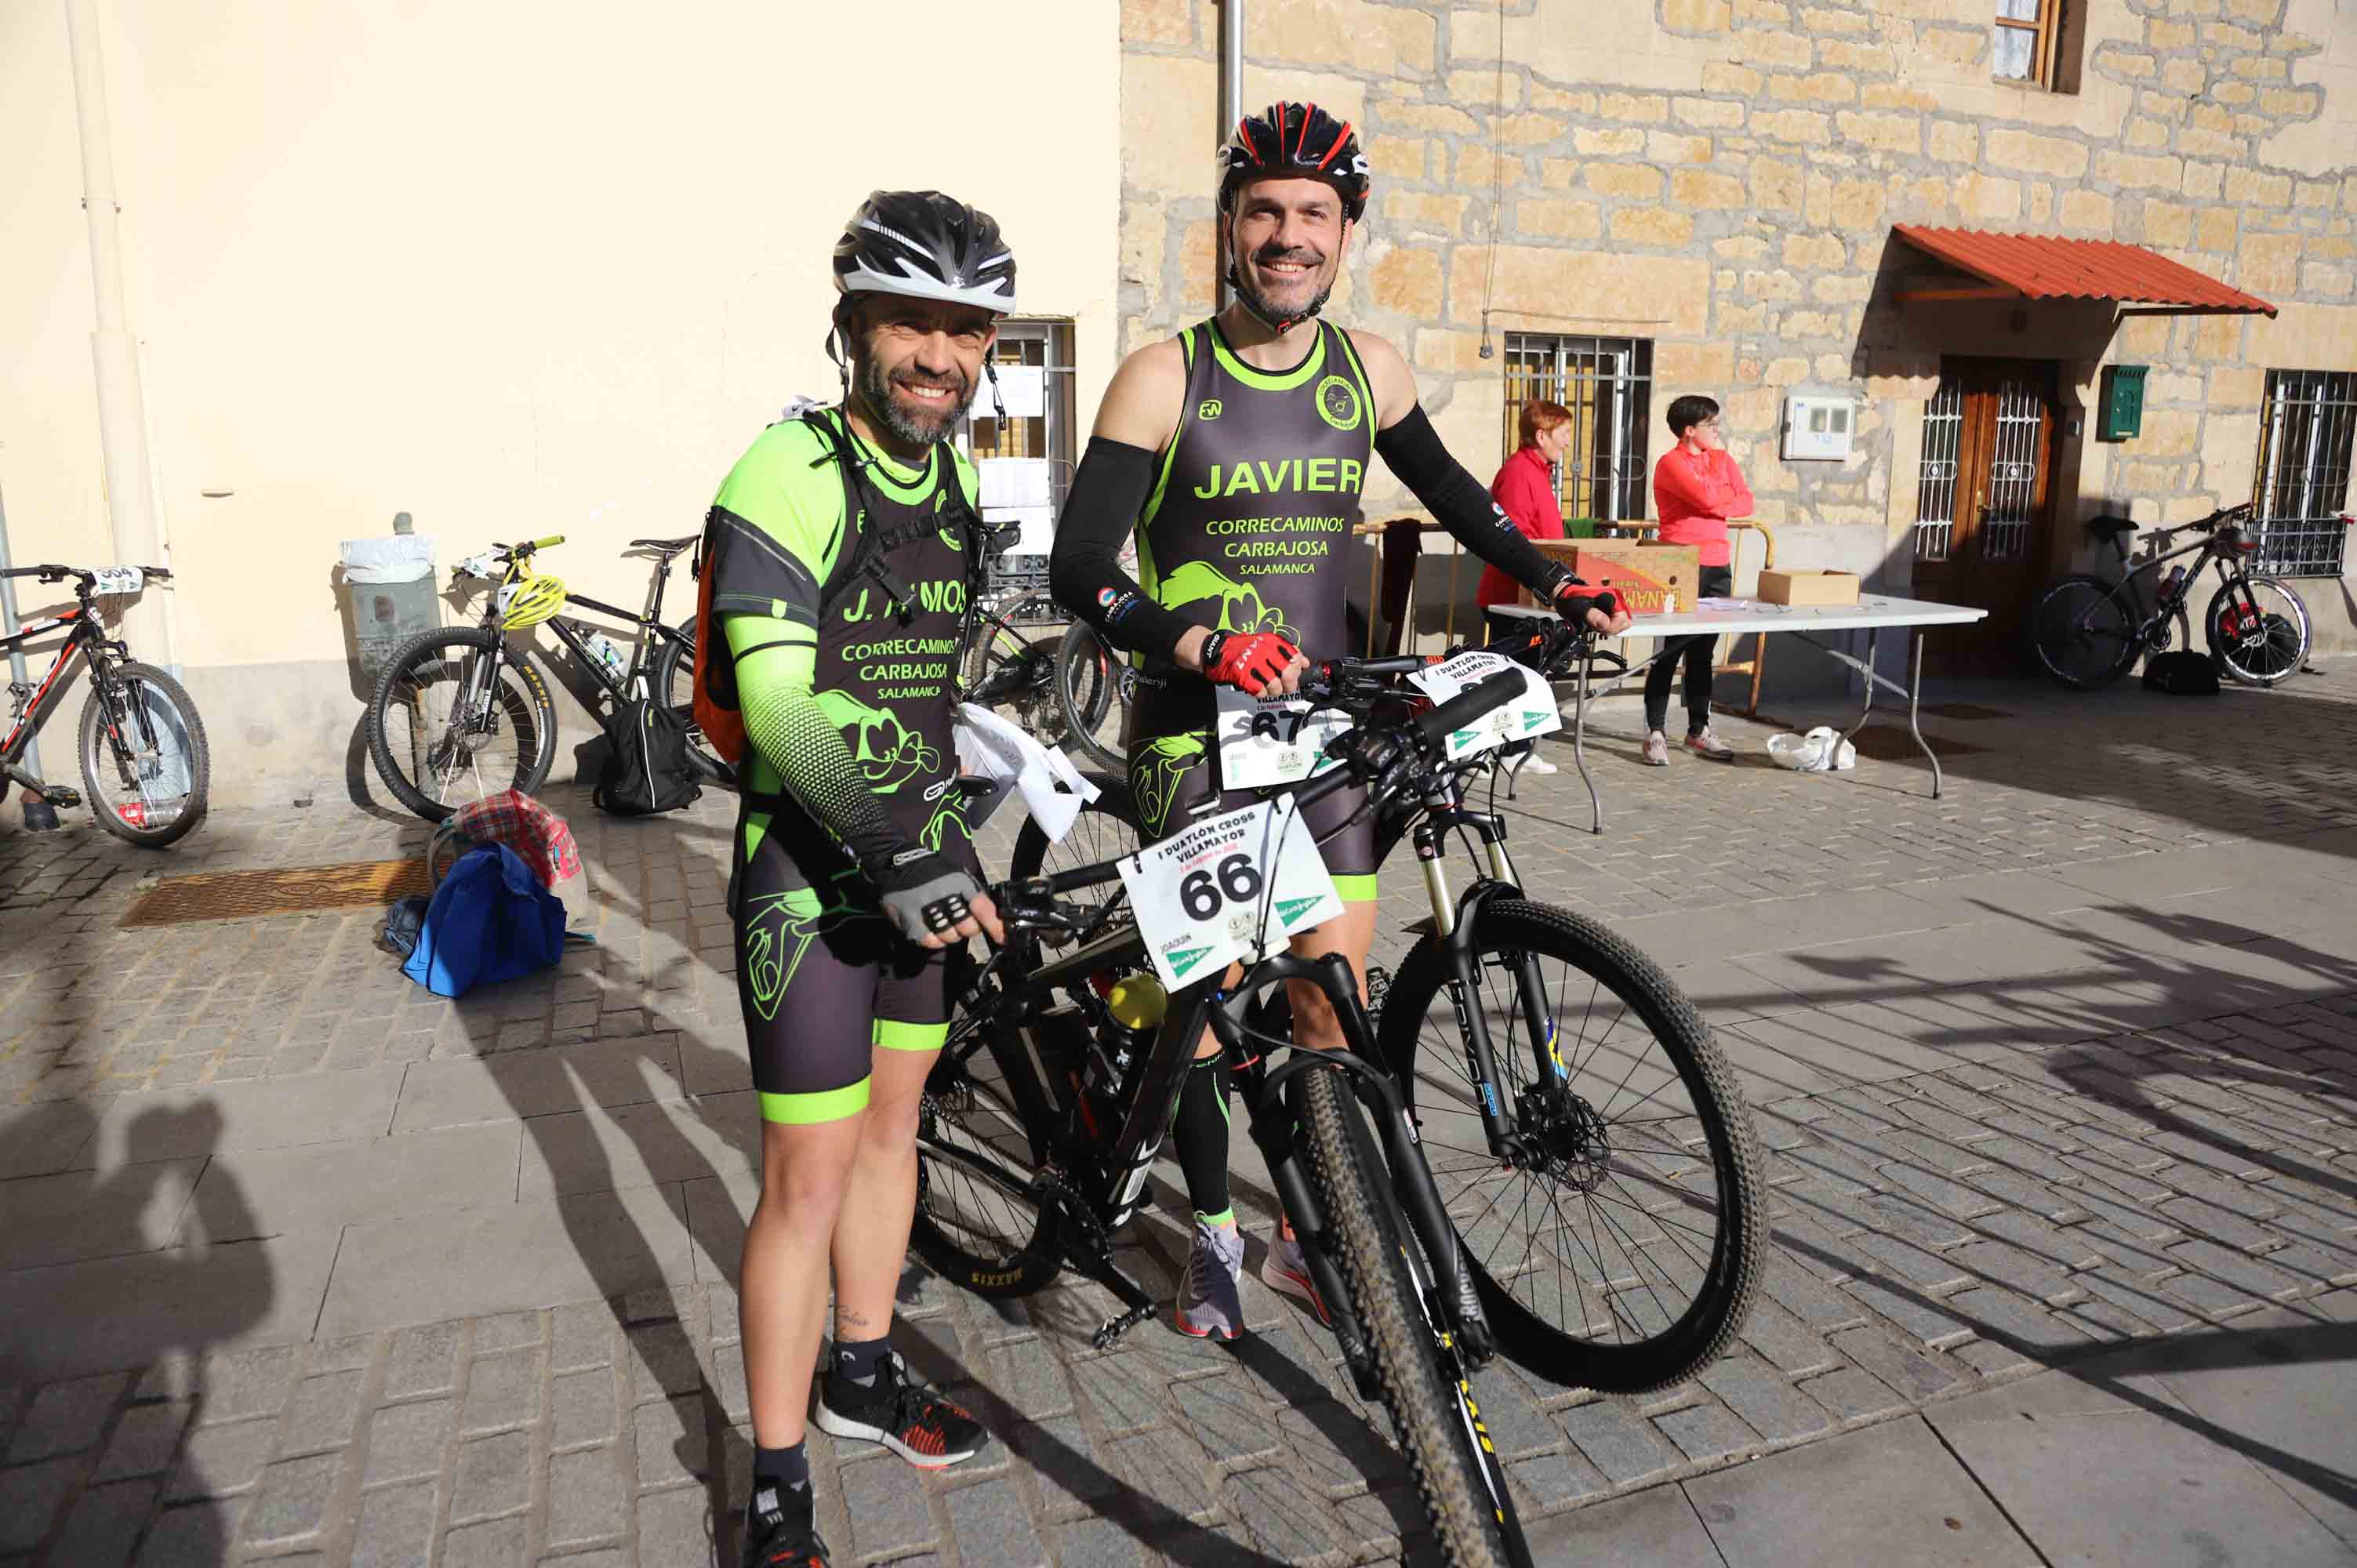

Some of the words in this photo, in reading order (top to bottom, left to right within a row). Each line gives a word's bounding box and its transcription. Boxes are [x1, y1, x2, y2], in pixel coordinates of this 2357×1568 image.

[1193, 458, 1362, 499] JAVIER
[1205, 517, 1345, 535] CORRECAMINOS
[1224, 541, 1328, 557] CARBAJOSA
[1240, 564, 1315, 575] SALAMANCA
[841, 638, 954, 662] CORRECAMINOS
[1207, 634, 1221, 659] GIANT
[859, 663, 947, 681] CARBAJOSA
[522, 665, 550, 709] MAXXIS
[877, 686, 941, 699] SALAMANCA
[1251, 710, 1306, 749] 67
[1218, 811, 1255, 831] CROSS
[1176, 829, 1246, 863] VILLAMAYOR
[1180, 854, 1262, 921] 66
